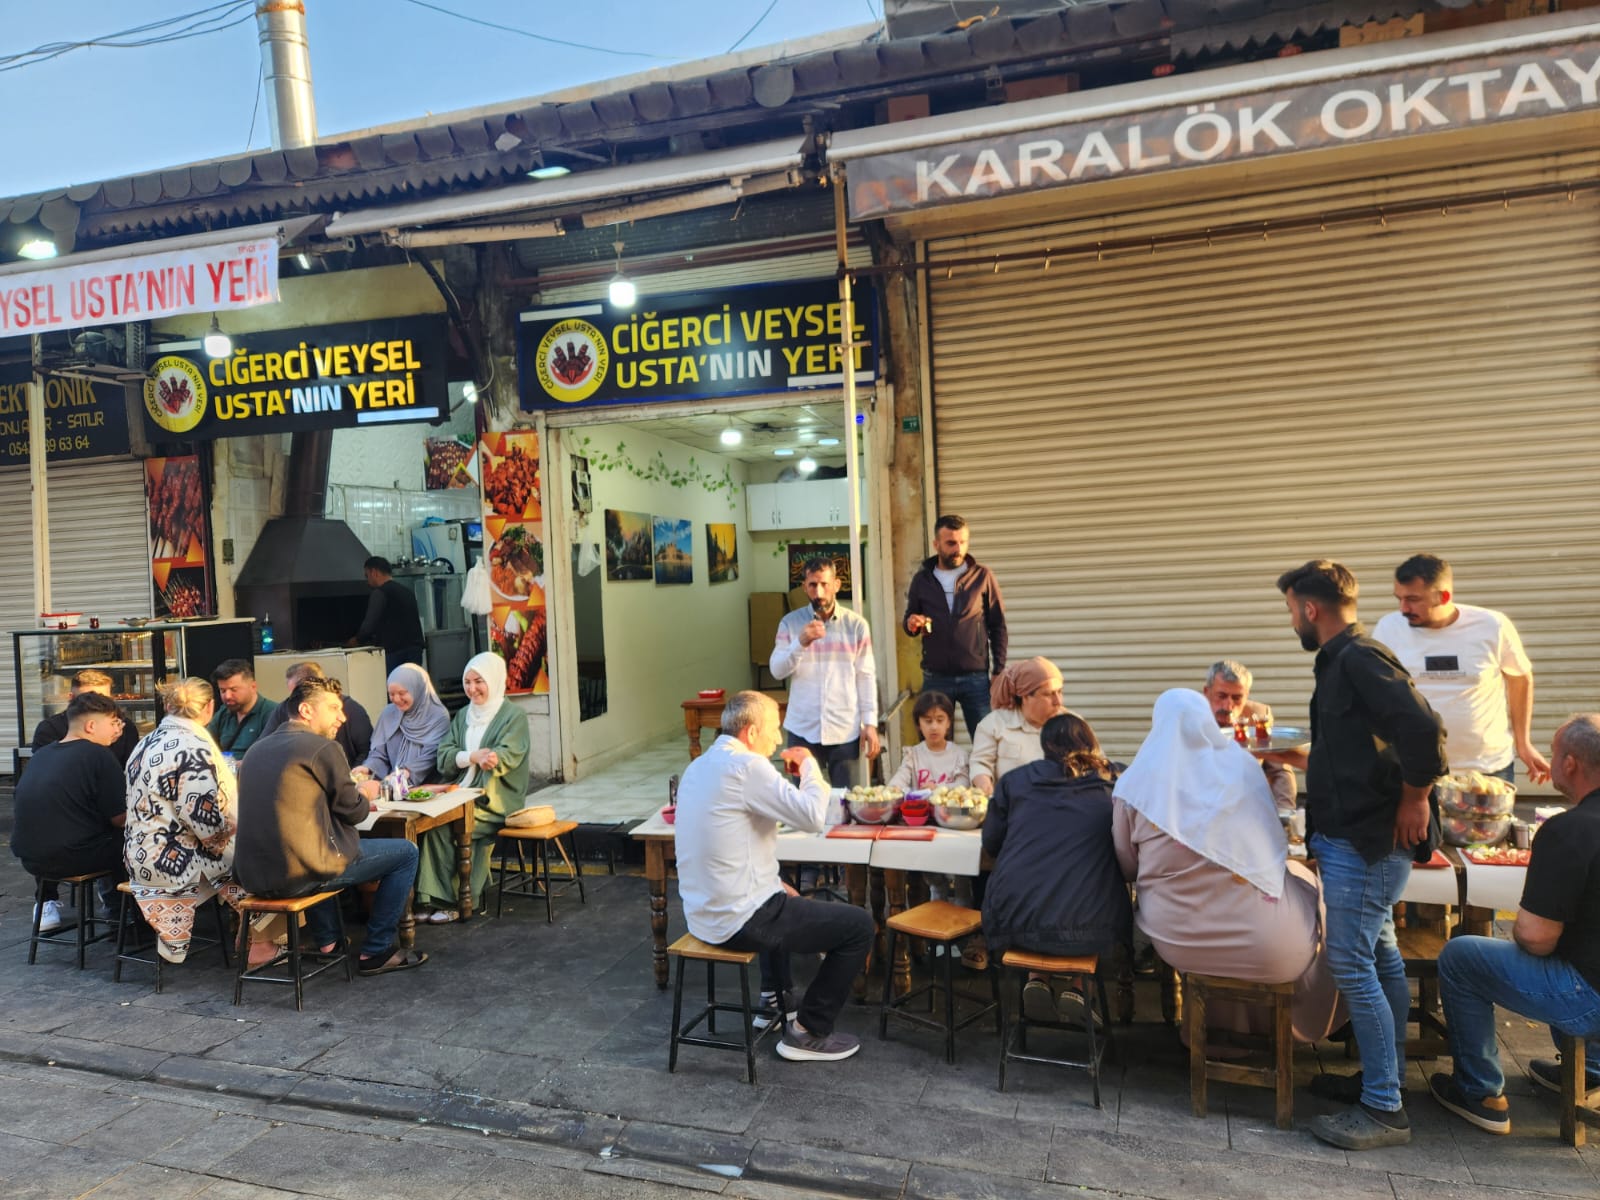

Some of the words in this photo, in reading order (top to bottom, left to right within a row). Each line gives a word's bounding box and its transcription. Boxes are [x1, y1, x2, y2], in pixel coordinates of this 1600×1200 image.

[917, 101, 1296, 202] KARALÖK
[1320, 55, 1600, 140] OKTAY
[70, 263, 195, 321] USTA'NIN
[206, 256, 270, 304] YERİ
[612, 304, 731, 354] CİĞERCİ
[740, 301, 865, 342] VEYSEL
[313, 339, 420, 379] VEYSEL
[616, 349, 771, 389] USTA'NIN
[0, 379, 97, 414] EKTONIK
[214, 384, 342, 420] USTA'NIN
[348, 373, 415, 409] YERİ
